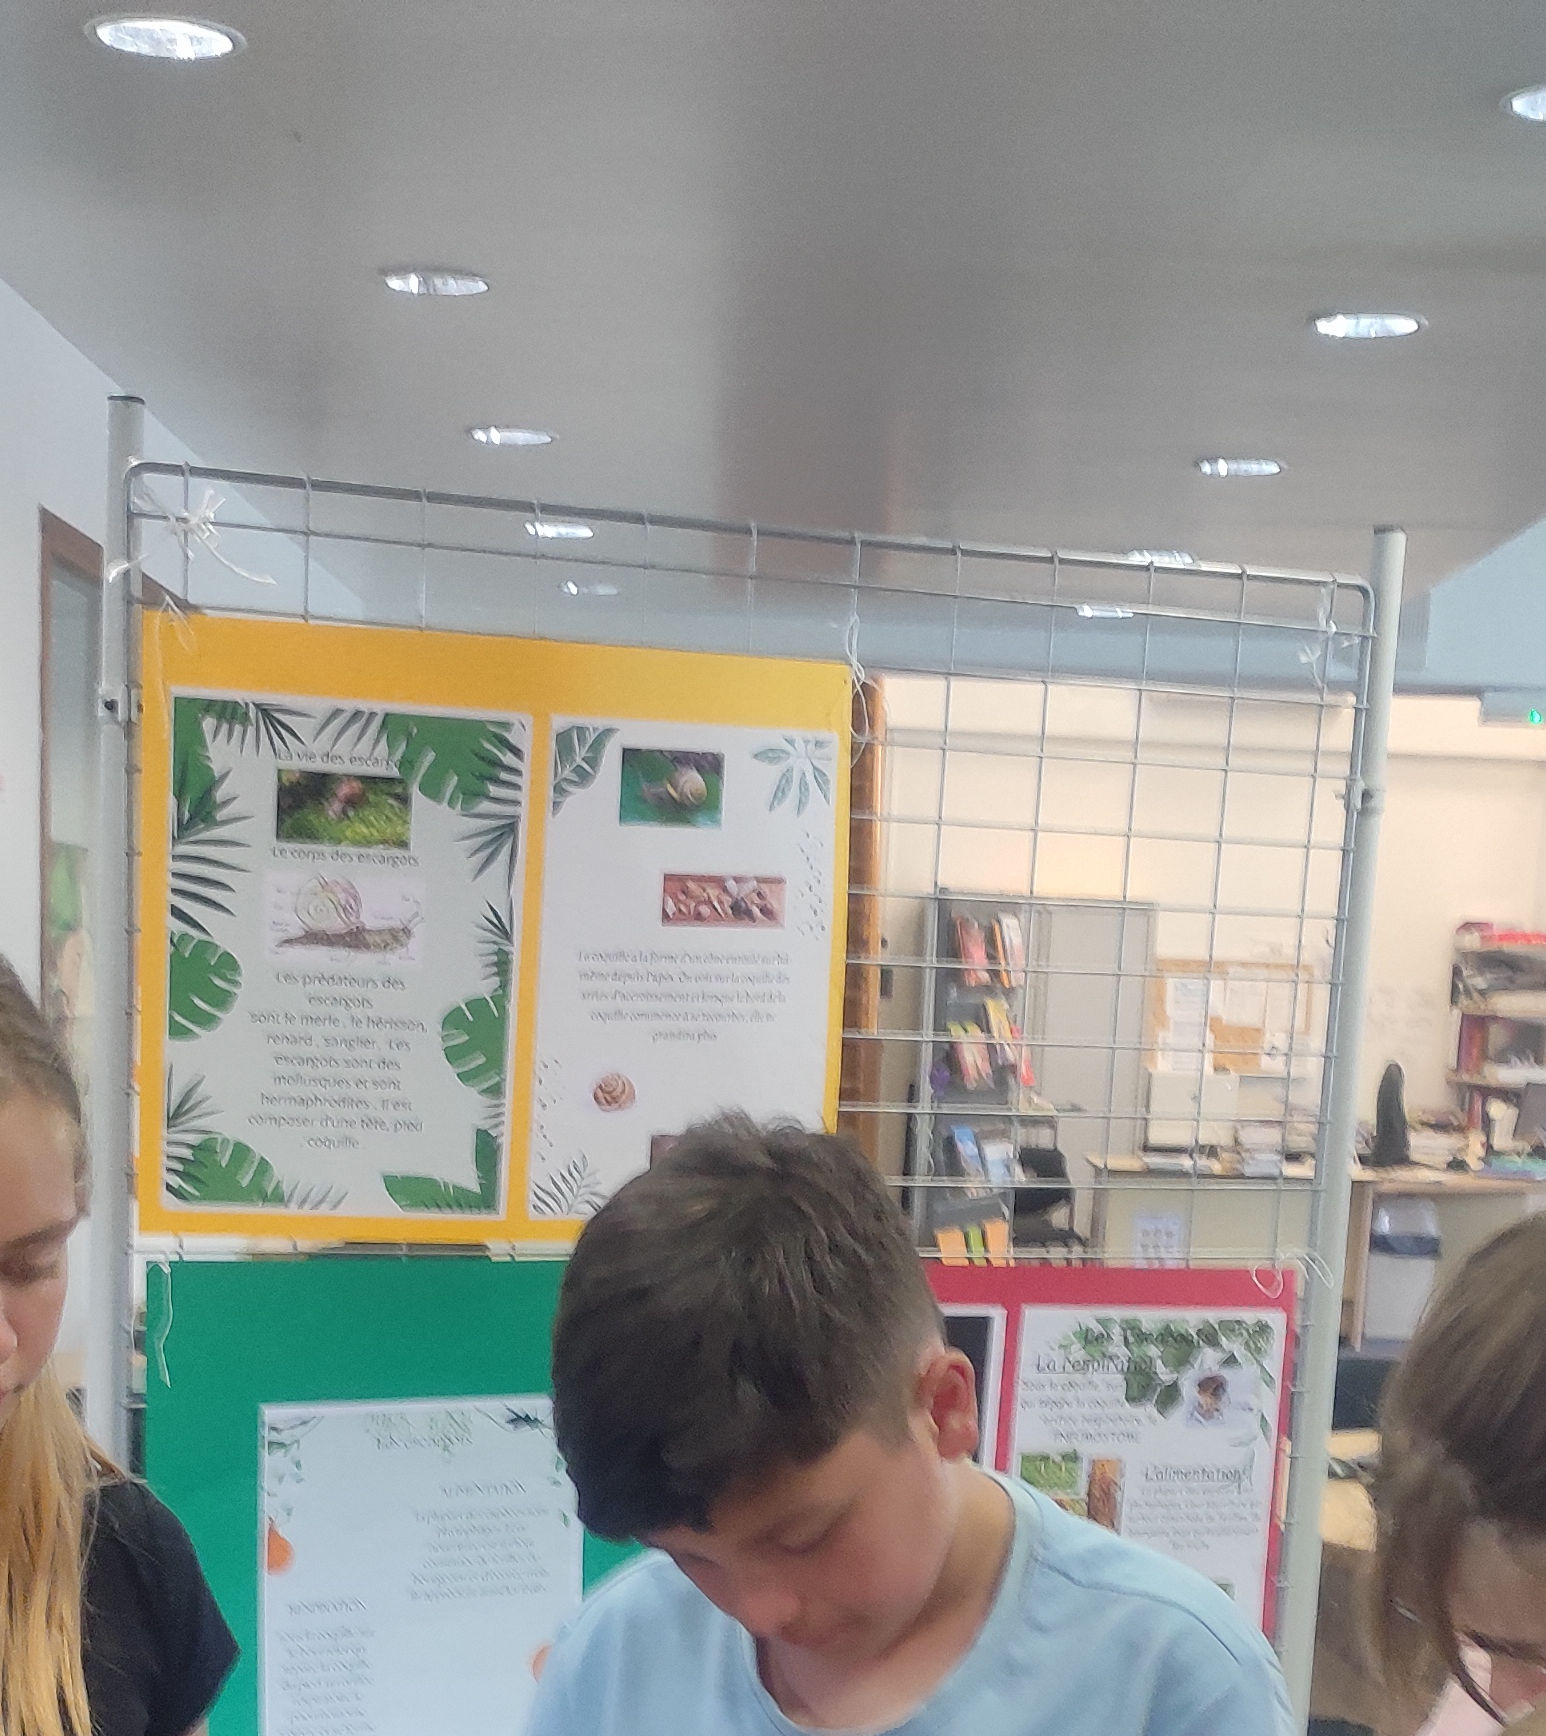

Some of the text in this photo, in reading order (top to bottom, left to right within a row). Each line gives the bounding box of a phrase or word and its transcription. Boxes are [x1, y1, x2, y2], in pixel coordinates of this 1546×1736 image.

[296, 752, 316, 764] vie
[320, 752, 346, 766] des
[291, 849, 328, 866] corps
[330, 850, 353, 864] des
[357, 850, 420, 869] escargots
[381, 976, 406, 992] des
[307, 993, 374, 1012] escargots
[274, 1054, 340, 1071] escargots
[376, 1056, 402, 1072] des
[273, 1072, 352, 1091] mollusques
[371, 1077, 402, 1092] sont
